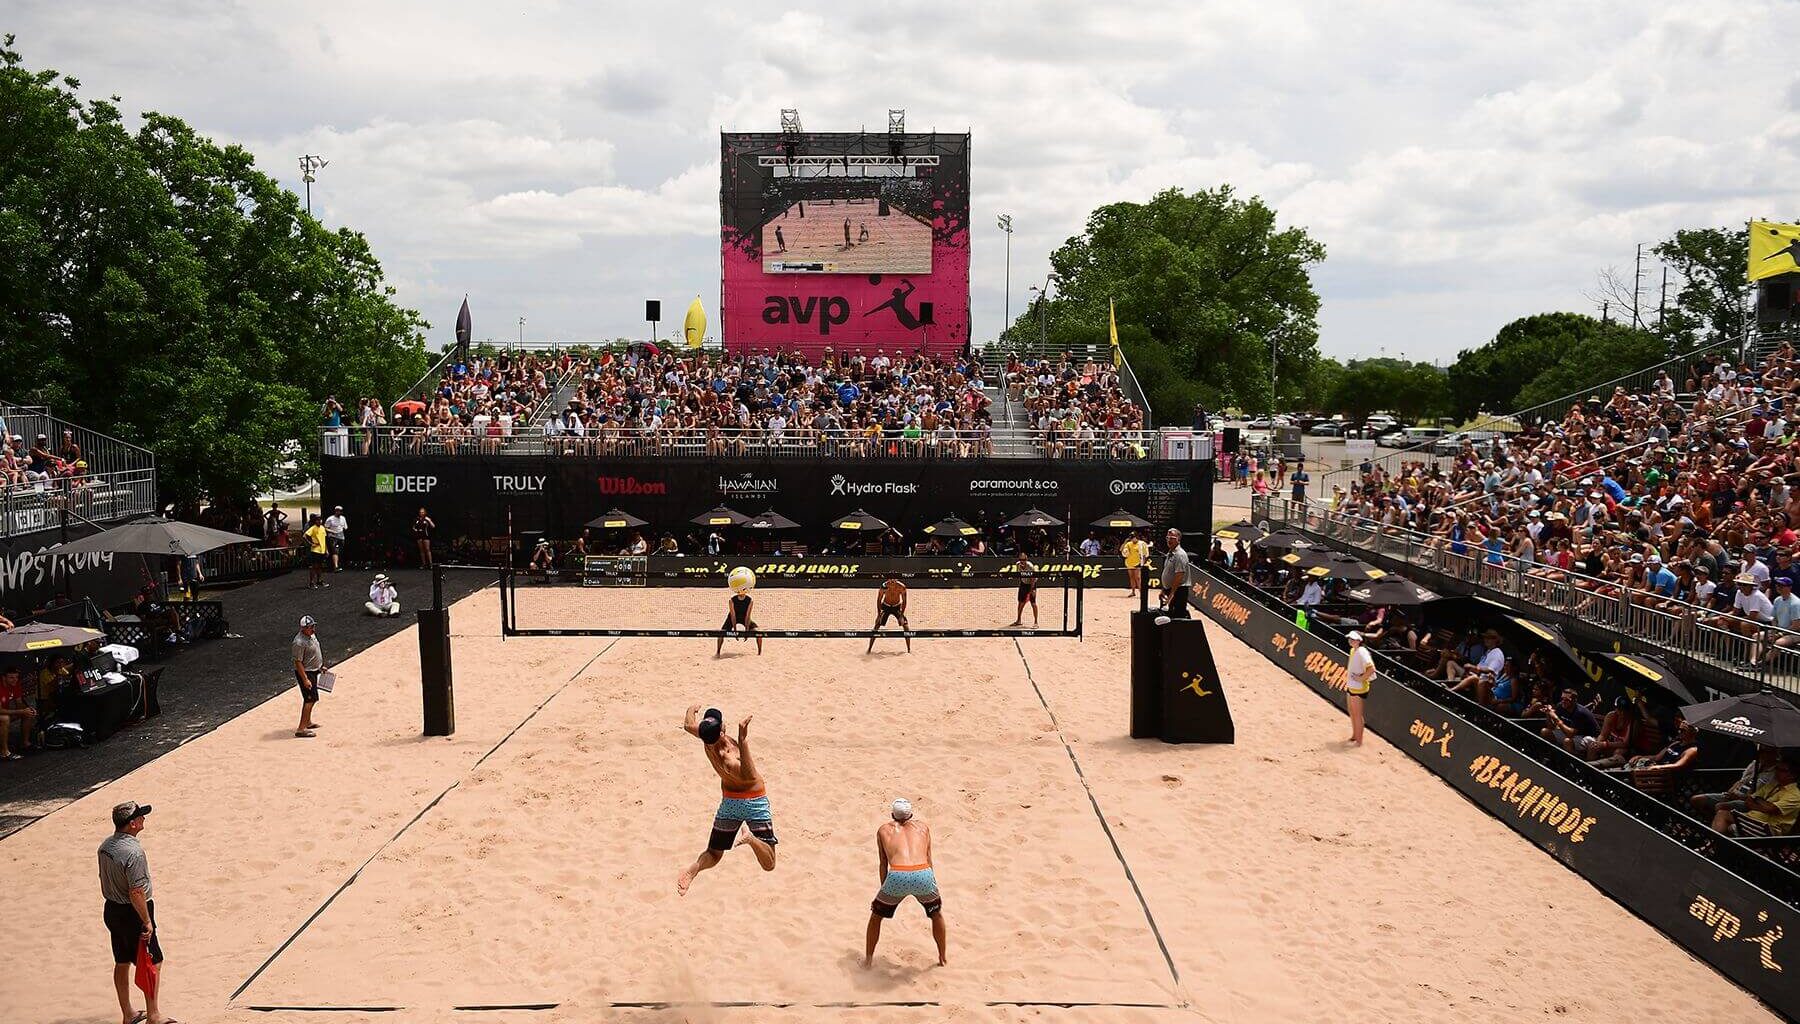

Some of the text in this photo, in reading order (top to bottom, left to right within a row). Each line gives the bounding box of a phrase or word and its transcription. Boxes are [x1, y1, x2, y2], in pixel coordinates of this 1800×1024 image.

[762, 295, 850, 335] avp
[395, 476, 438, 492] DEEP
[493, 475, 546, 490] TRULY
[598, 476, 666, 494] Wilson
[719, 476, 777, 495] HAWAIIAN
[847, 482, 917, 496] Hydro Flask
[1304, 651, 1348, 690] #BEACHM
[1409, 719, 1597, 842] avp #BEACHMODE
[1689, 894, 1740, 942] avp
